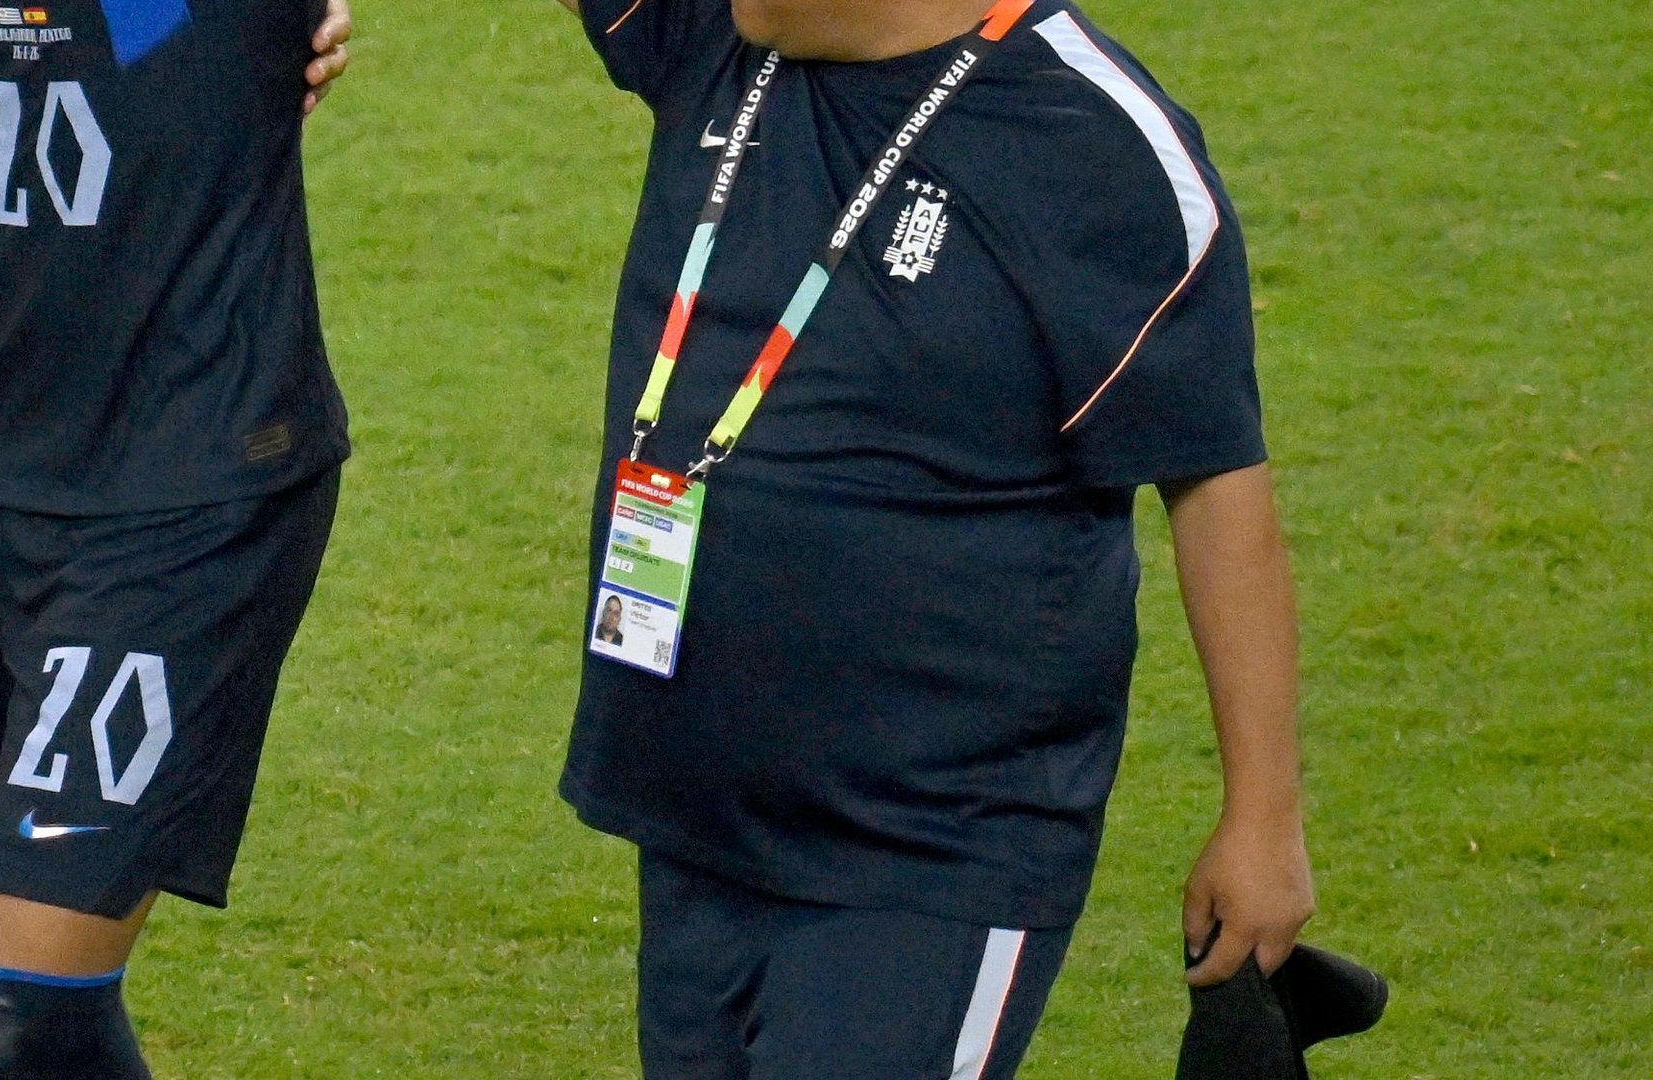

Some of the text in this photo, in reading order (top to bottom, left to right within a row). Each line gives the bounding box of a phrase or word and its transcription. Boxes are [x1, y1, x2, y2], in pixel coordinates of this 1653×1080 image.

[710, 50, 781, 204] FIFA WORLD CUP
[831, 49, 978, 250] FIFA WORLD CUP 2026
[908, 209, 931, 244] AUF
[636, 483, 659, 496] WORLD
[7, 645, 173, 806] 20
